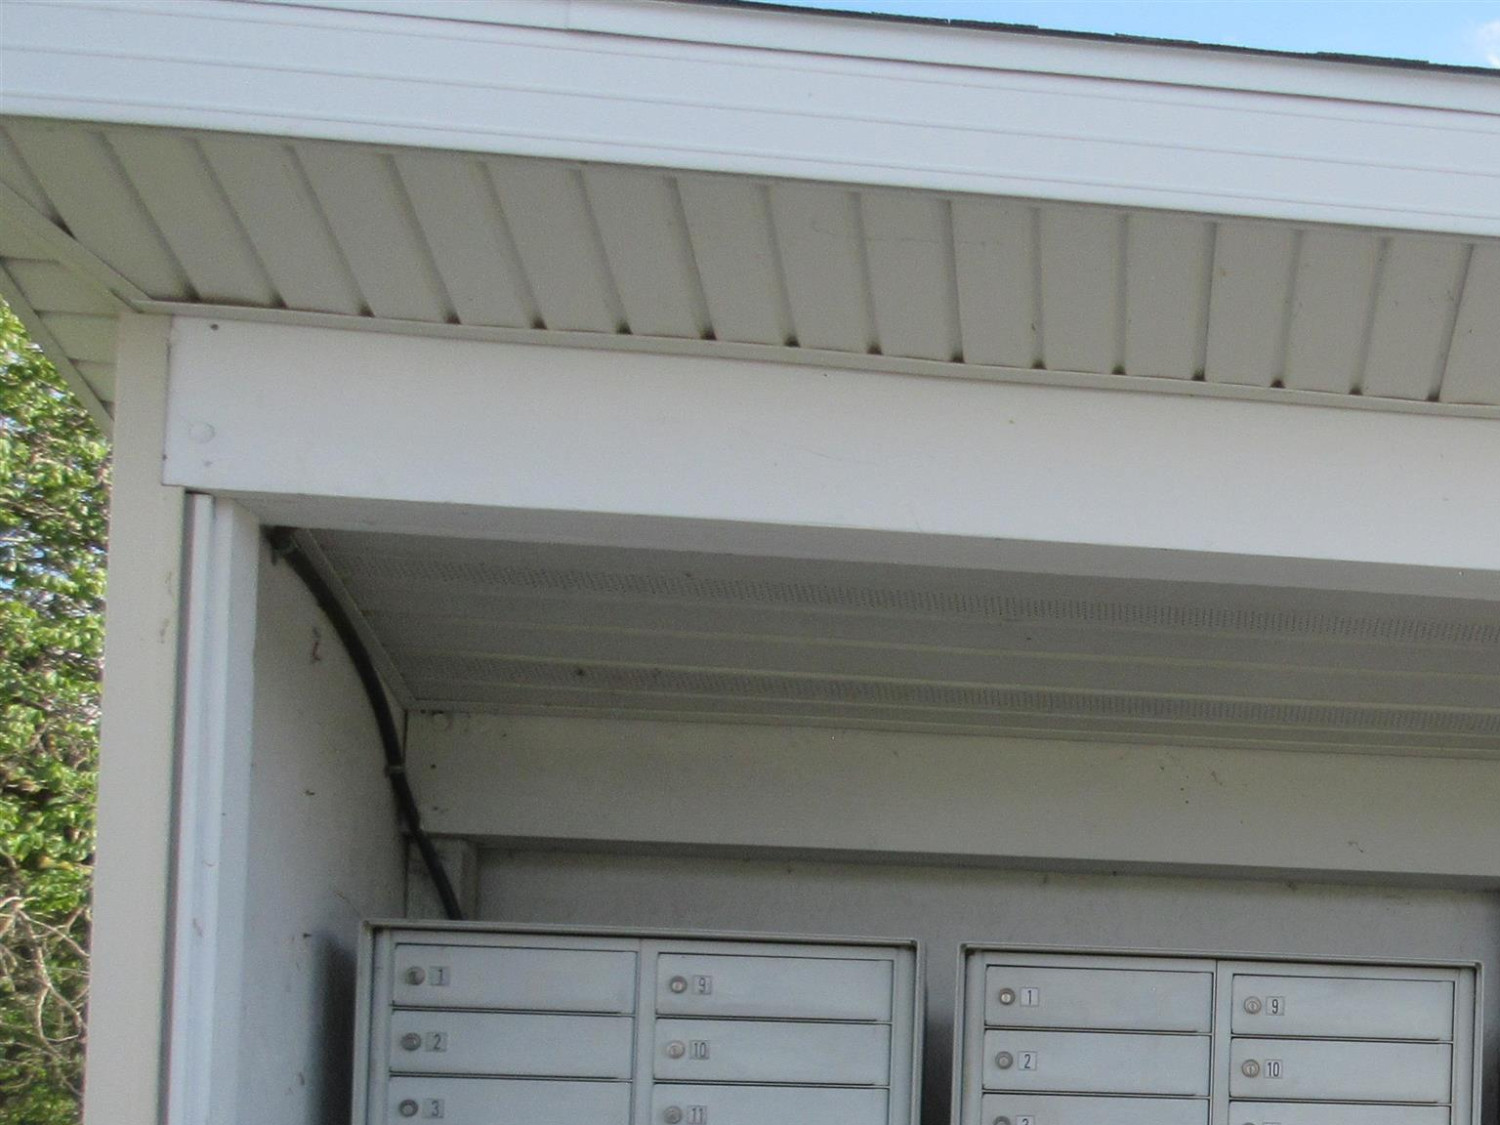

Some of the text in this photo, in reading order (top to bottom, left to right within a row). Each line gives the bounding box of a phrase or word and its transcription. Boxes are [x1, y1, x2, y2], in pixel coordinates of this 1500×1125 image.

[698, 976, 706, 994] 9
[1271, 998, 1279, 1015] 9
[433, 1034, 442, 1051] 2
[693, 1041, 707, 1059] 10
[1023, 1053, 1031, 1069] 2
[1267, 1061, 1280, 1078] 10
[431, 1100, 440, 1118] 3
[691, 1107, 704, 1124] 11
